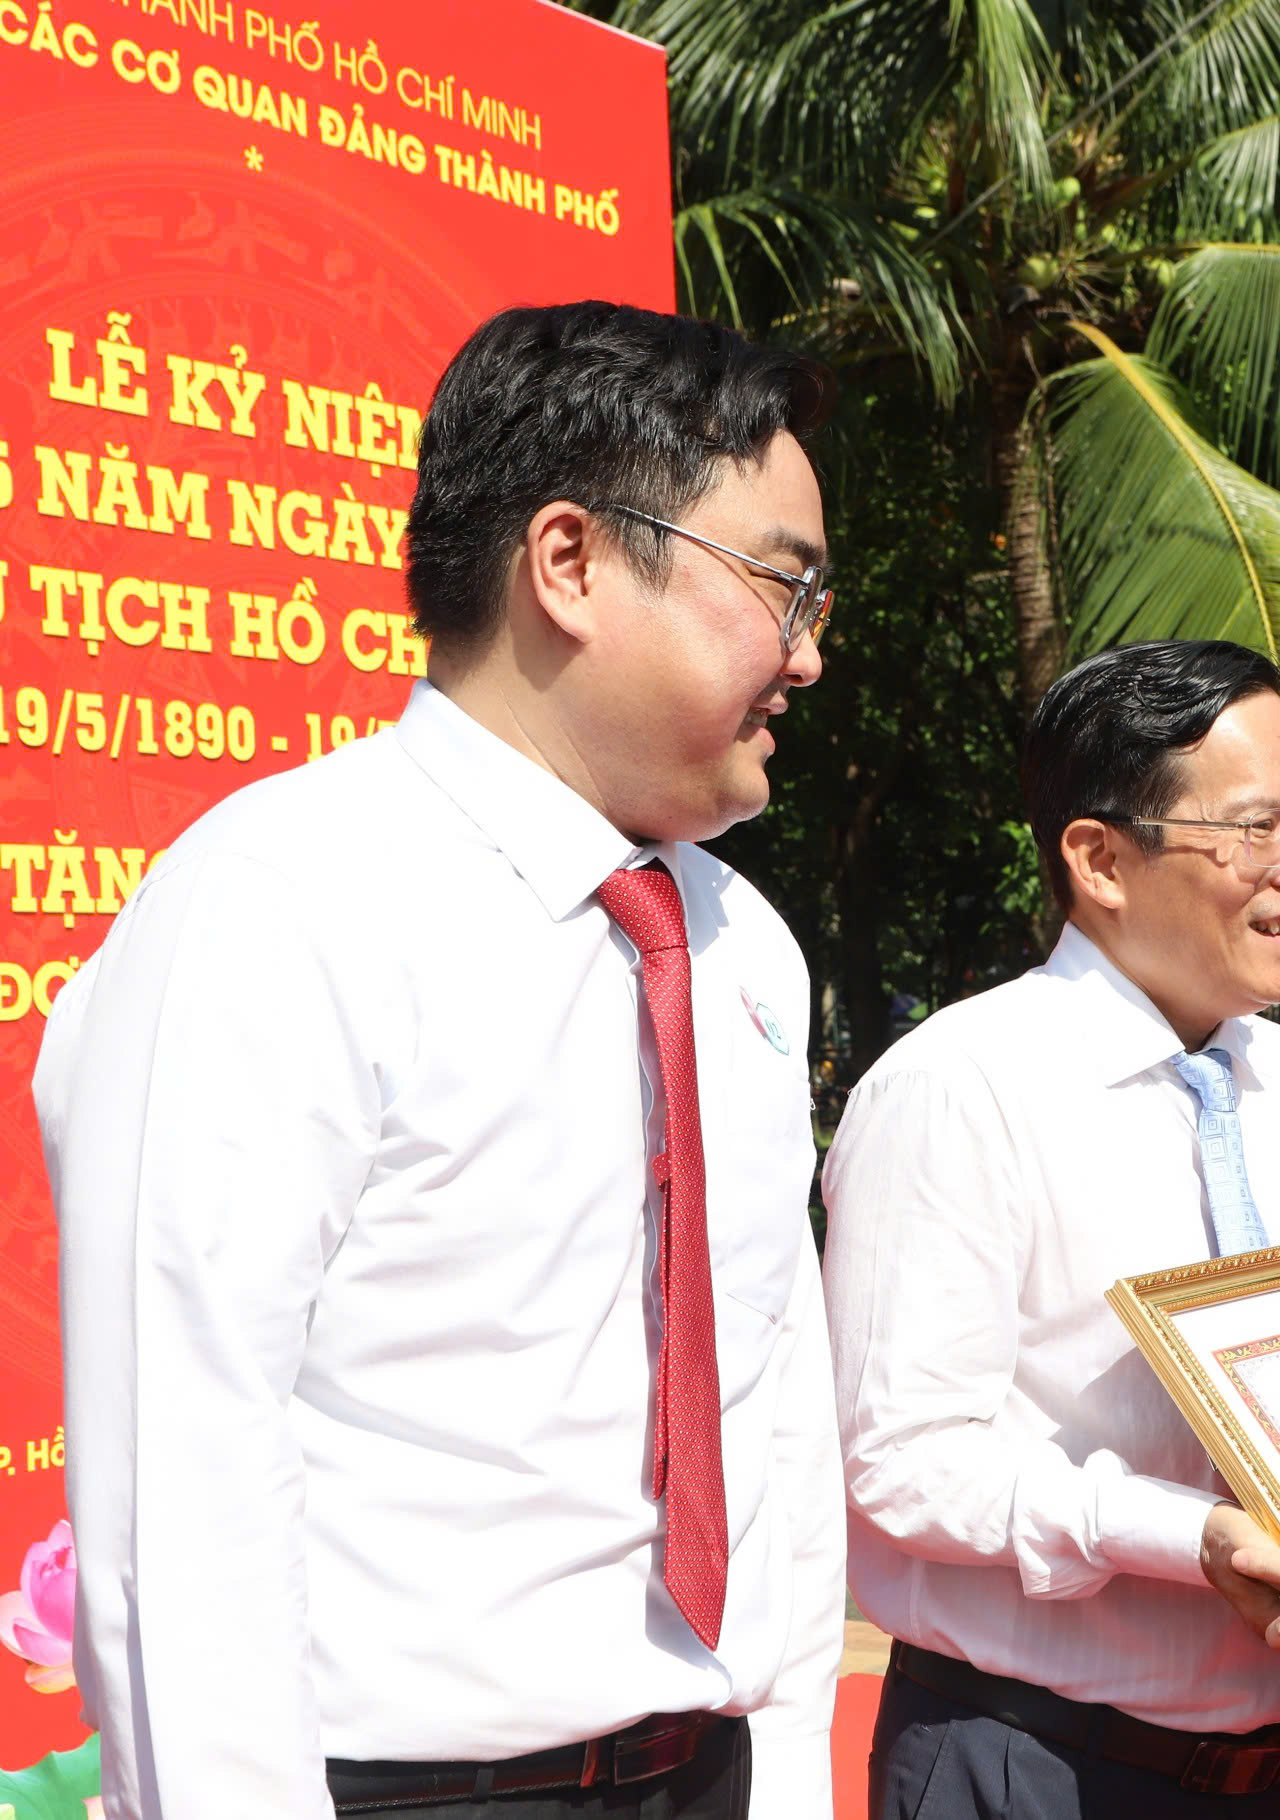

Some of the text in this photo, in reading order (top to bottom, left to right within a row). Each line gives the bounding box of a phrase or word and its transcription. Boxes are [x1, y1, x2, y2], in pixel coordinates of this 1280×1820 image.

[0, 0, 620, 236] CÁC CƠ QUAN ĐẢNG THÀNH PHỐ
[246, 10, 324, 71] PHỐ
[335, 39, 388, 94] HỒ
[397, 68, 455, 119] CHÍ
[463, 90, 541, 150] MINH
[47, 312, 148, 416] LỄ
[167, 345, 265, 437] KỶ
[35, 442, 212, 540] NĂM
[228, 481, 410, 570] NGÀY
[30, 565, 213, 656] TỊCH
[229, 577, 326, 665] HỒ
[0, 829, 168, 929] TẶN
